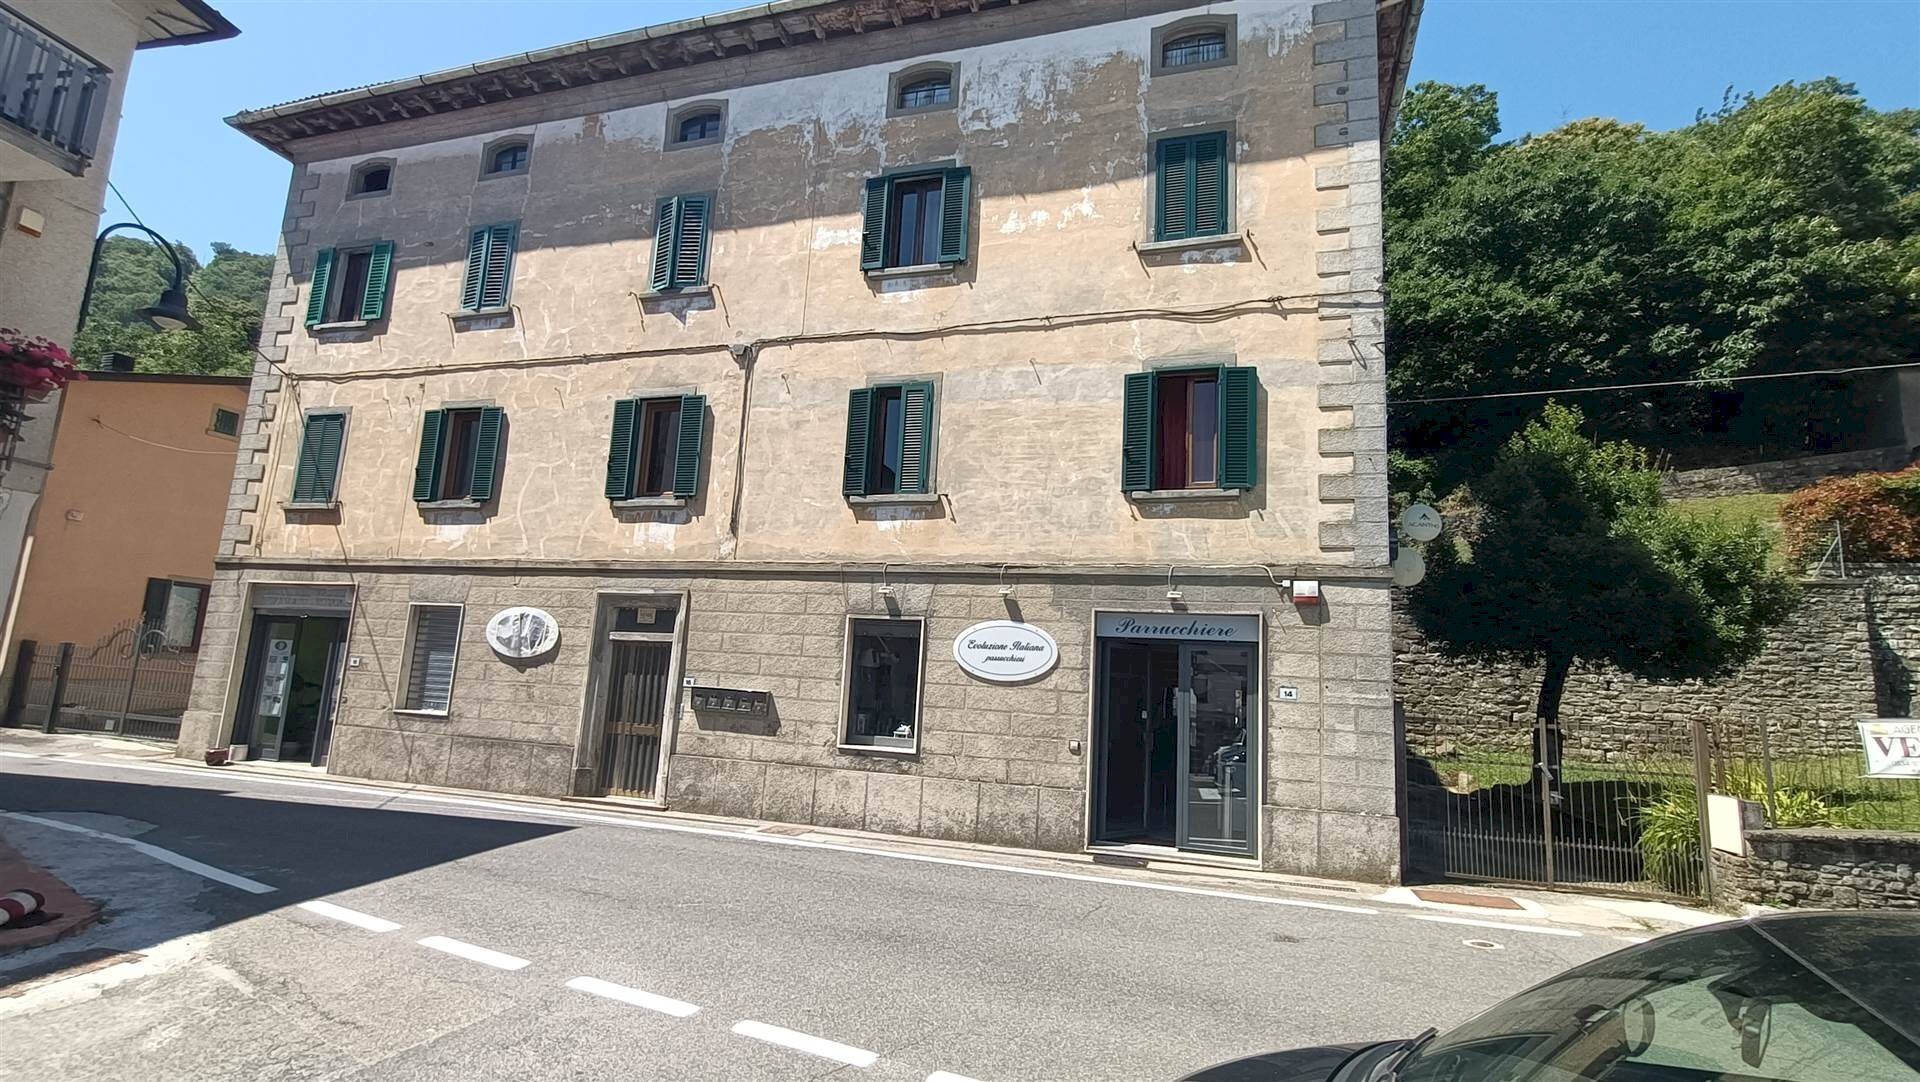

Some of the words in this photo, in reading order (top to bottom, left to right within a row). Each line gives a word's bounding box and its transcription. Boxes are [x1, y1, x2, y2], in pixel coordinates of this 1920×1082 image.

[1115, 617, 1237, 637] Parrucchiere
[967, 639, 1008, 652] Evoluzione
[1009, 640, 1045, 652] Italiana
